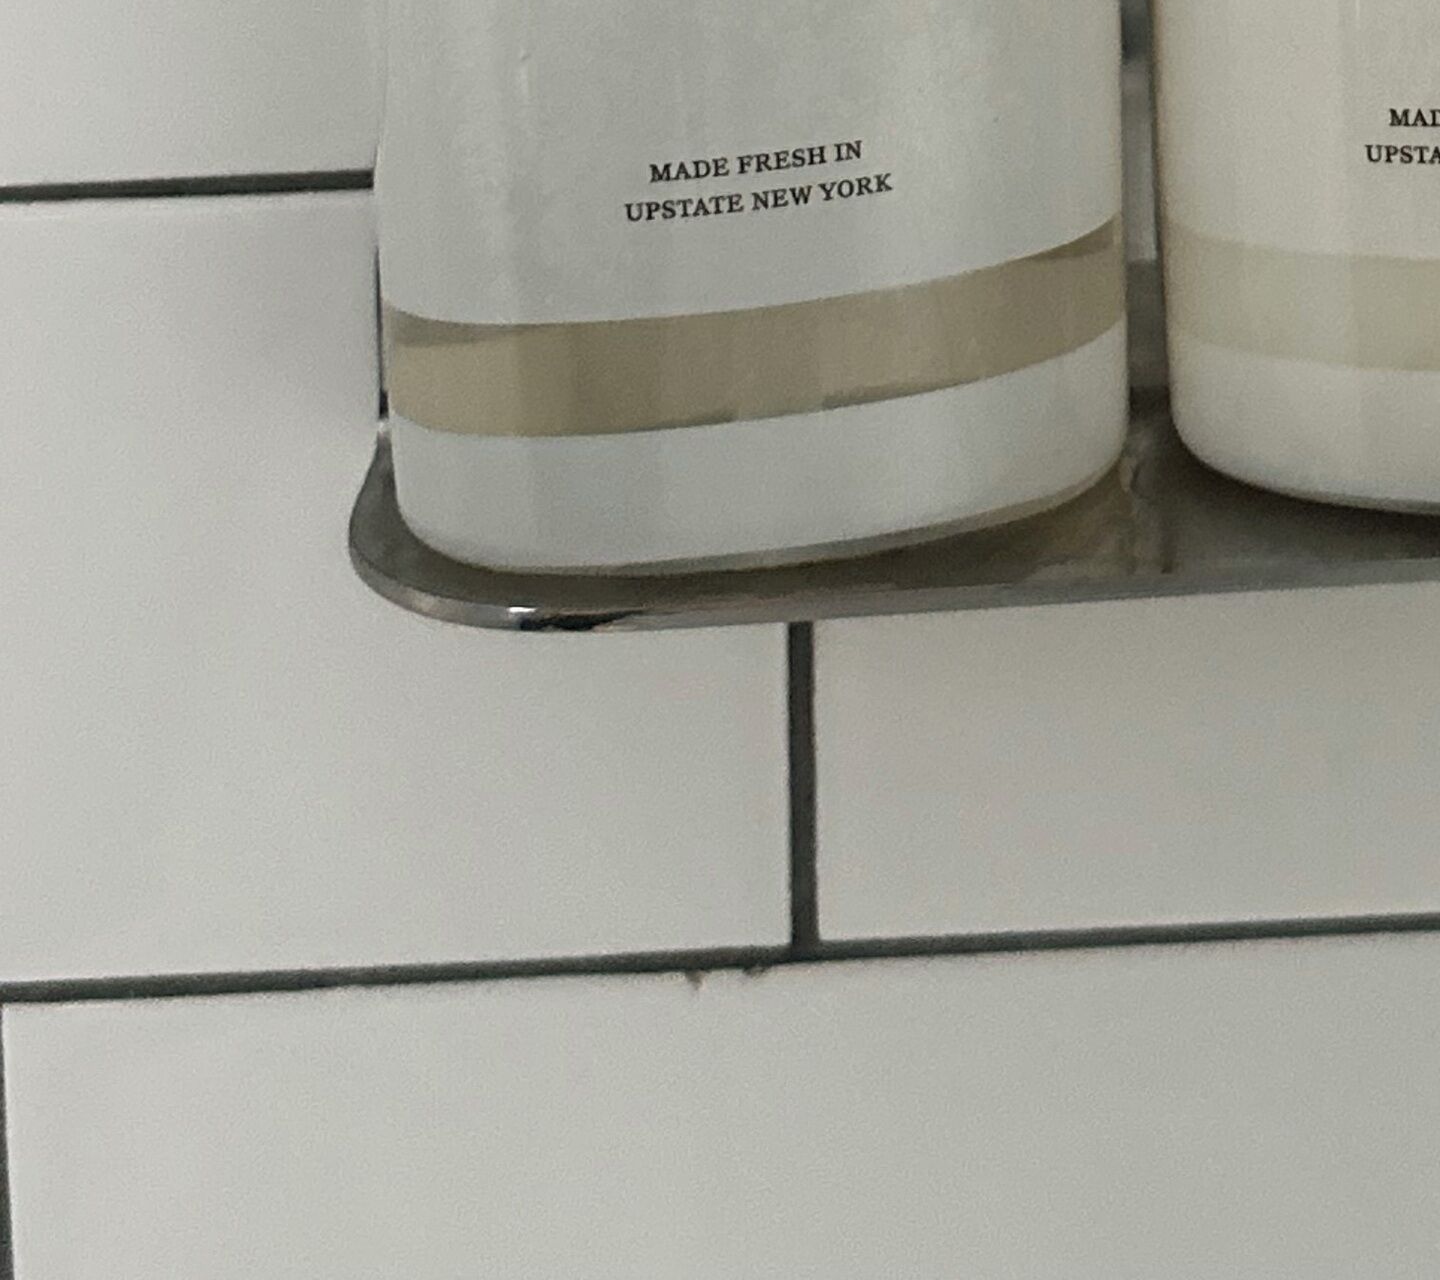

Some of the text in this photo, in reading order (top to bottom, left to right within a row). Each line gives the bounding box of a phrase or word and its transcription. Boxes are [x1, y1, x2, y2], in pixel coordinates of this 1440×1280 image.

[648, 139, 863, 184] MADE FRESH IN
[623, 172, 894, 223] UPSTATE NEW YORK
